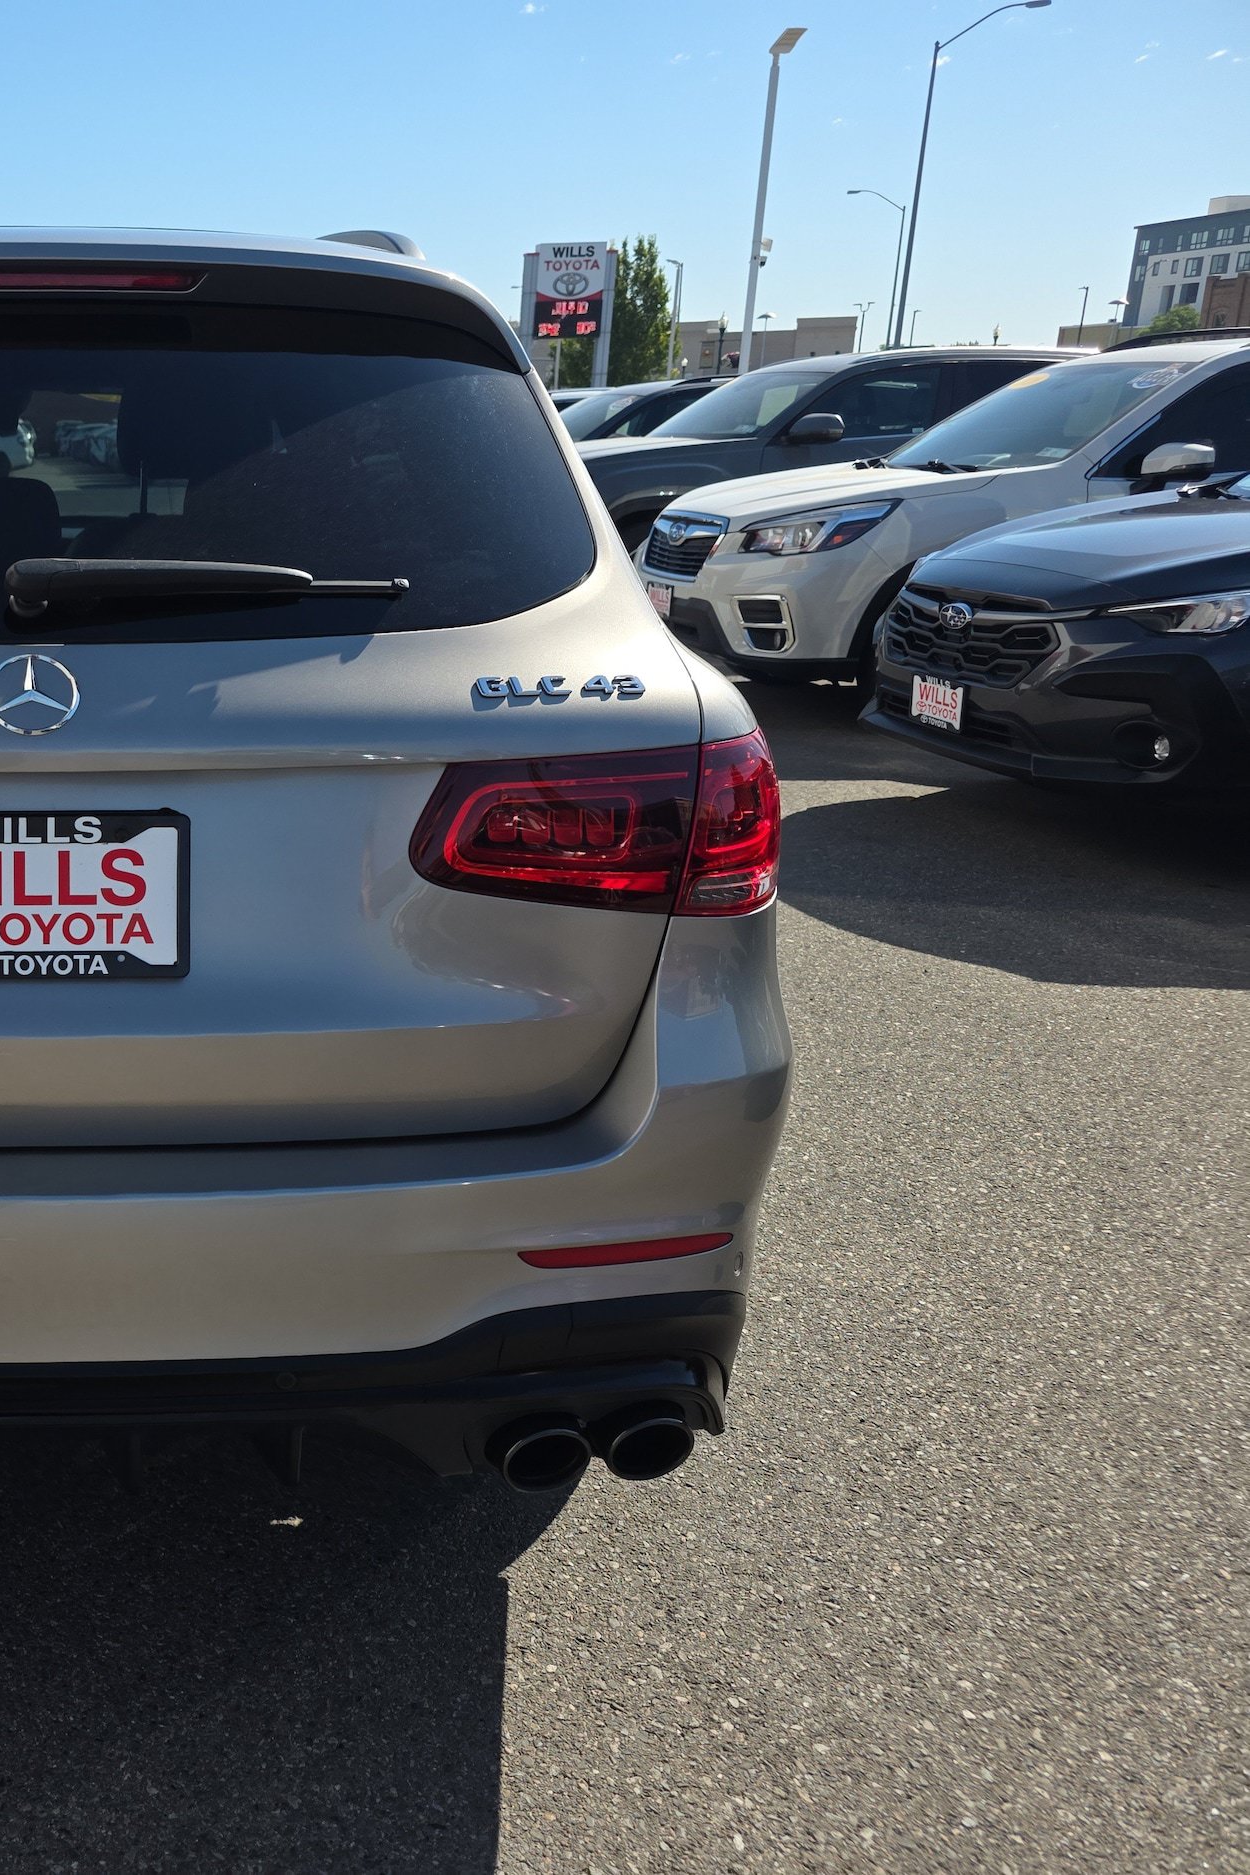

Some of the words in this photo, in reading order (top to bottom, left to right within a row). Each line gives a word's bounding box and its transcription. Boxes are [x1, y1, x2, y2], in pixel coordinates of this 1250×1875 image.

[552, 245, 595, 258] WILLS
[544, 259, 600, 272] TOYOTA
[474, 675, 572, 698] GLC
[584, 674, 646, 695] 43
[926, 675, 951, 689] WILLS
[919, 683, 958, 710] WILLS
[927, 703, 957, 722] TOYOTA
[928, 717, 948, 729] TOYOTA
